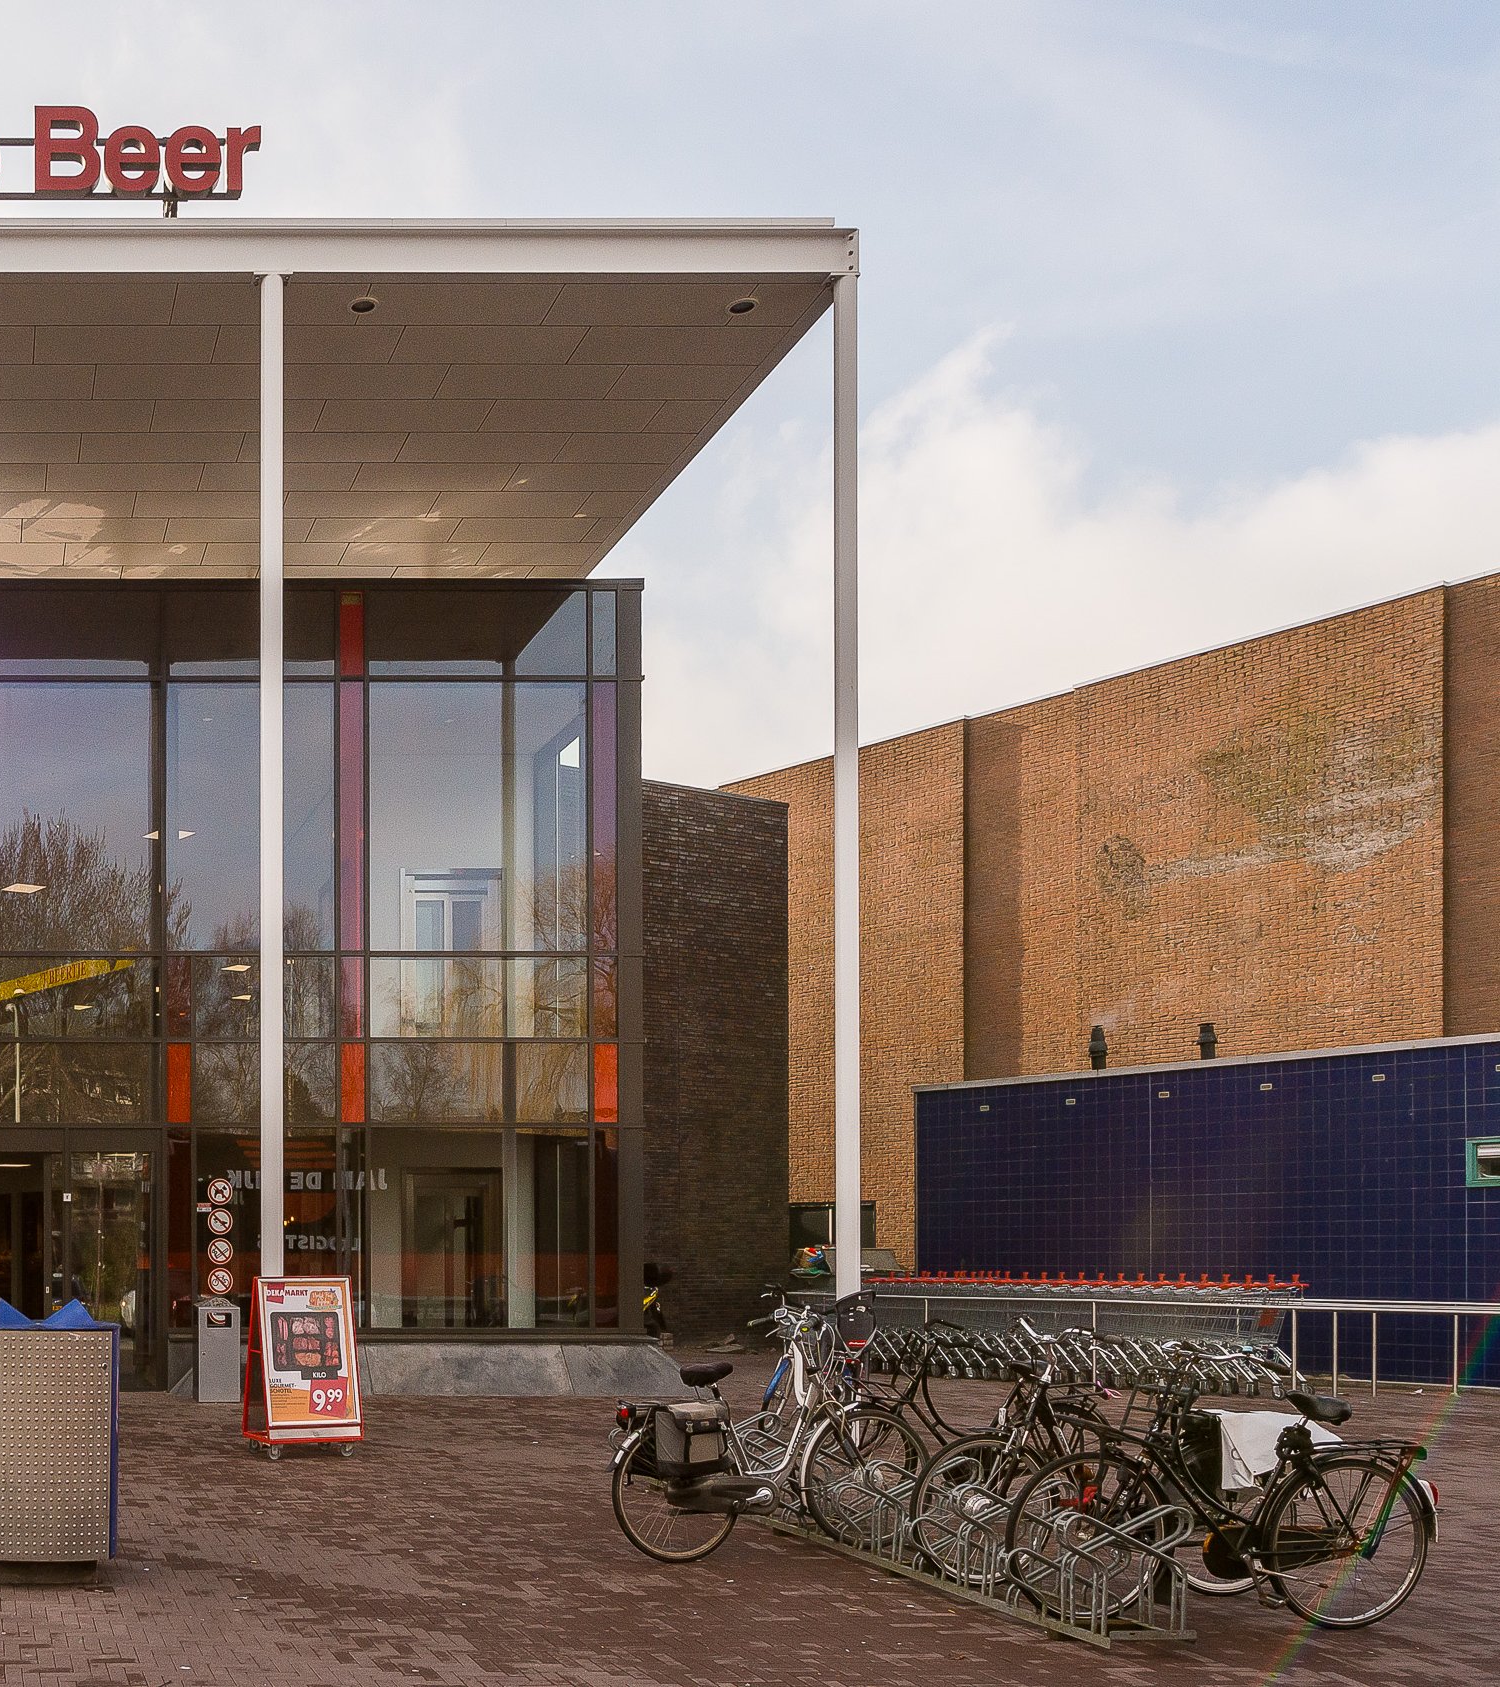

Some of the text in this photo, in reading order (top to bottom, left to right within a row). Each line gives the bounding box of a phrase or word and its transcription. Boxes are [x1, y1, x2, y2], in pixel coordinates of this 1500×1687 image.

[34, 105, 261, 198] Beer
[267, 1289, 308, 1299] DEKAMARKT
[312, 1388, 343, 1412] 9.99
